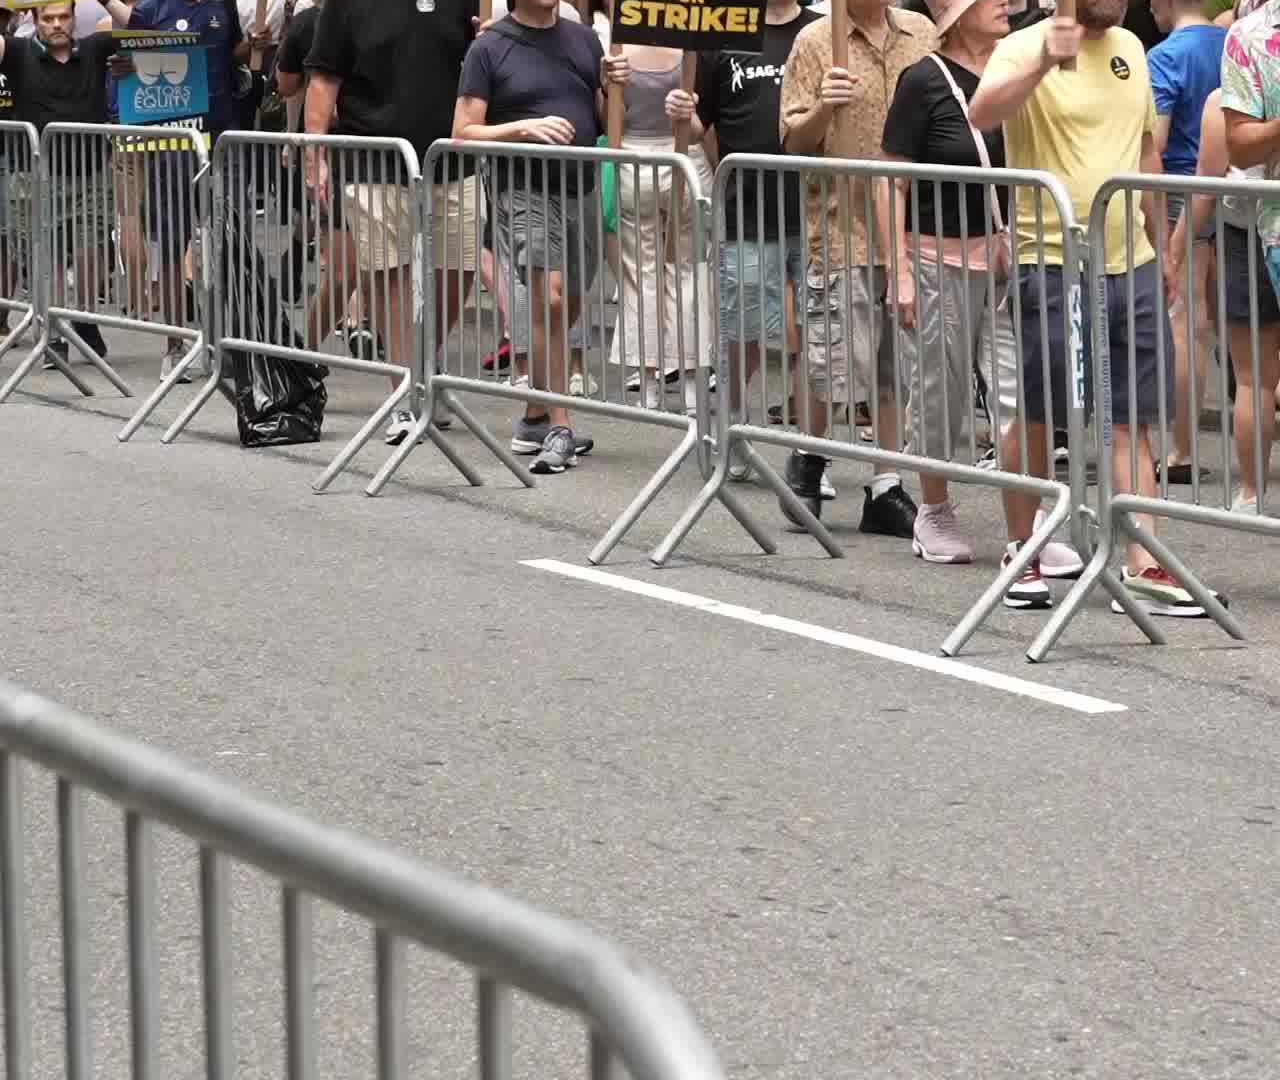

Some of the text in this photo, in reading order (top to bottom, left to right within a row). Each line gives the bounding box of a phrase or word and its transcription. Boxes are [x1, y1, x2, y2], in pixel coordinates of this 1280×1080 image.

[620, 0, 760, 33] STRIKE!
[135, 85, 192, 98] ACTORS
[134, 94, 191, 109] EQUITY
